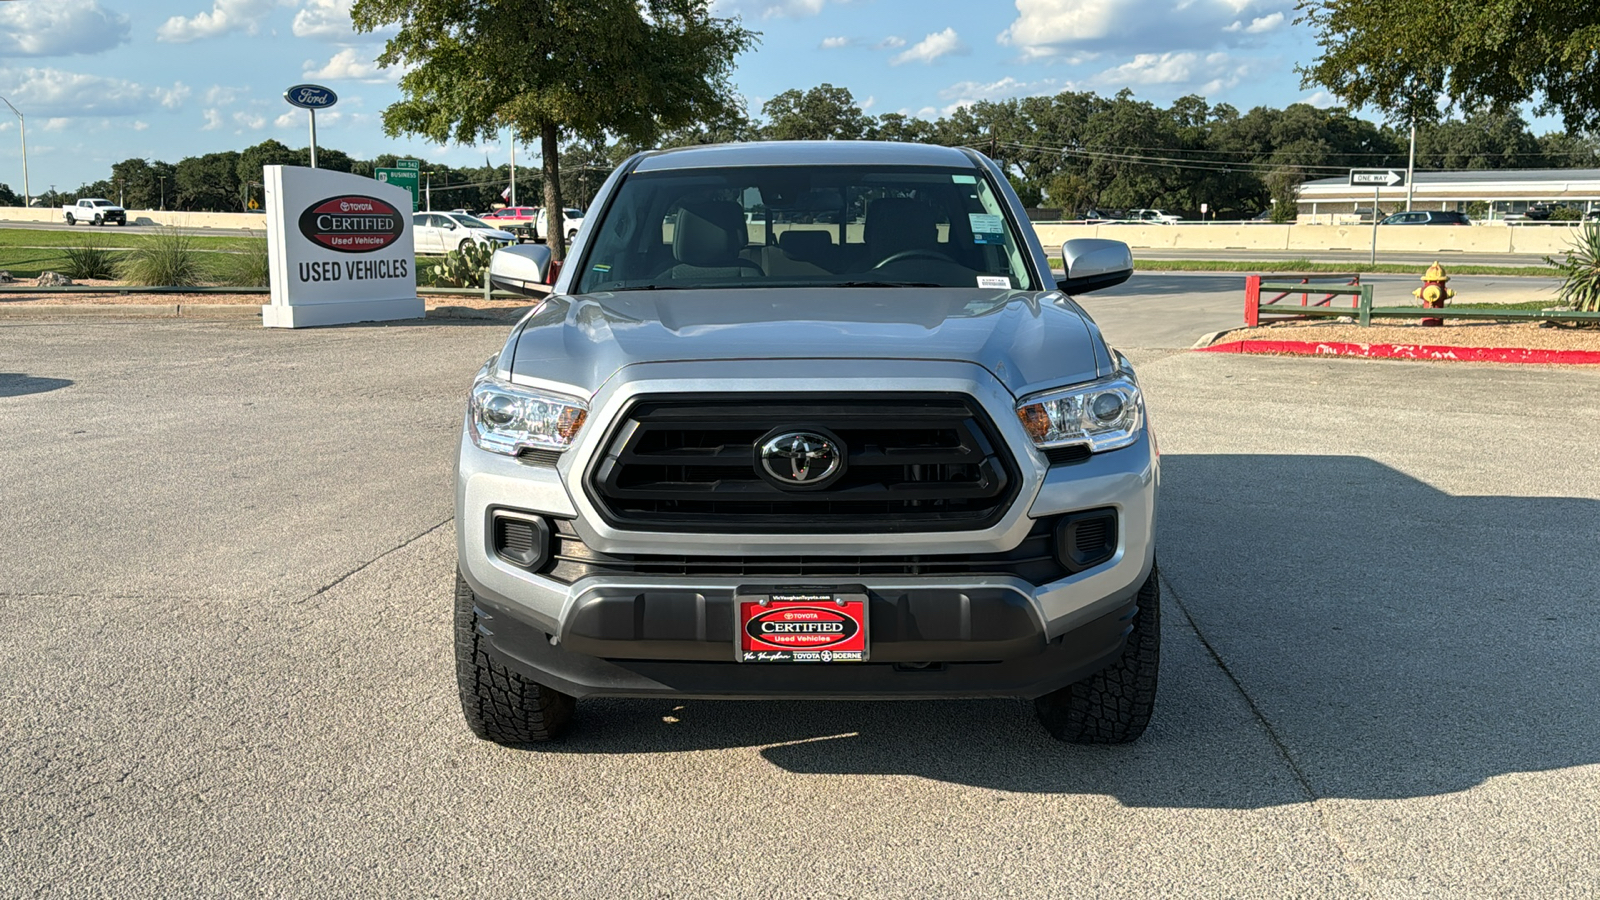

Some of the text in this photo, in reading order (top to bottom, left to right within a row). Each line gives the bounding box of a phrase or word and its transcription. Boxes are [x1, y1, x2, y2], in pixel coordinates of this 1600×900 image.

[298, 88, 328, 104] Ford
[390, 171, 417, 179] BUSINESS
[349, 203, 373, 211] TOYOTA
[316, 214, 394, 231] CERTIFIED
[331, 237, 384, 245] Used Vehicles
[299, 259, 408, 282] USED VEHICLES
[761, 621, 844, 633] CERTIFIED
